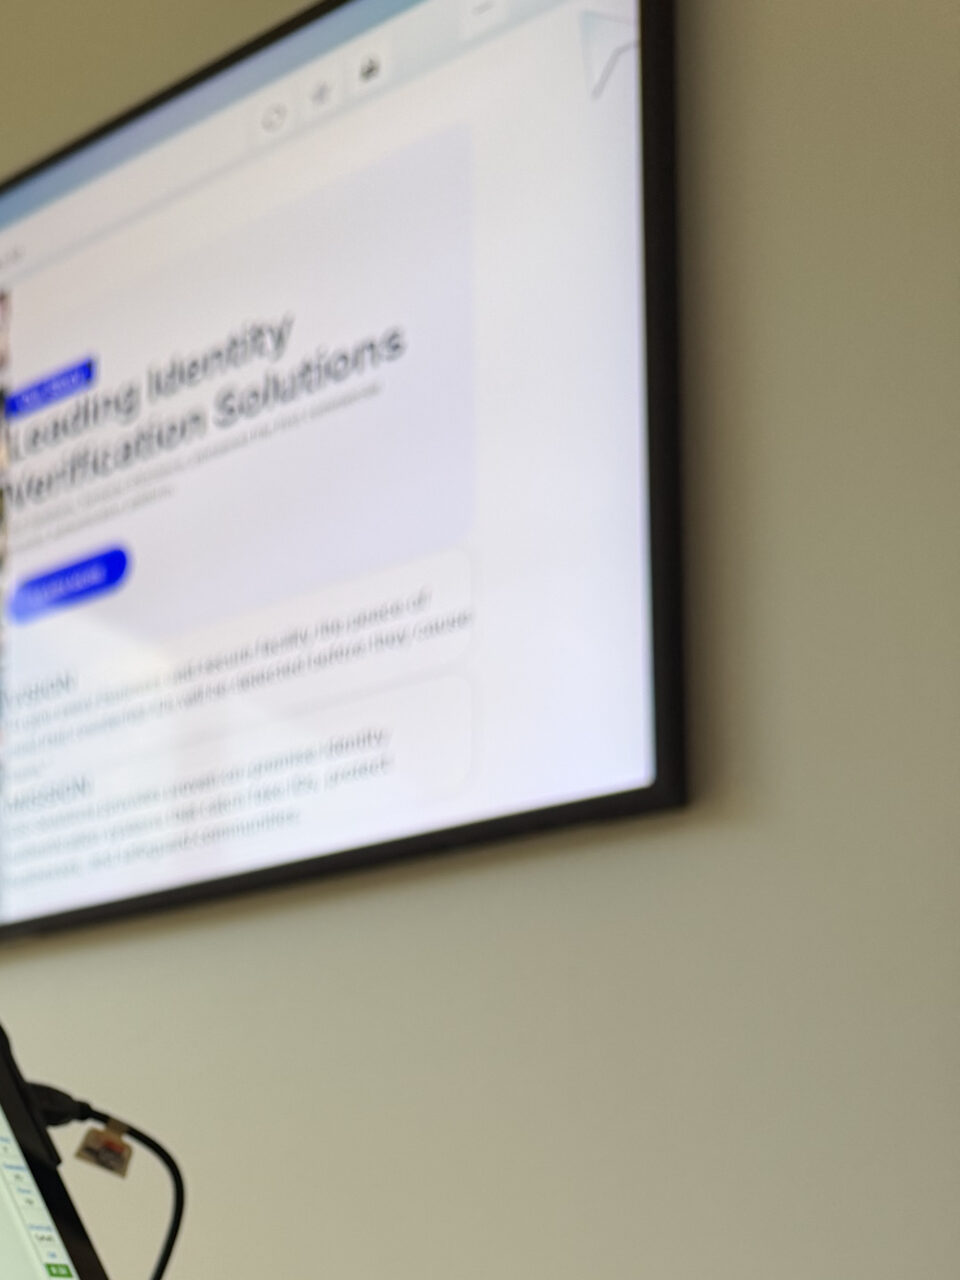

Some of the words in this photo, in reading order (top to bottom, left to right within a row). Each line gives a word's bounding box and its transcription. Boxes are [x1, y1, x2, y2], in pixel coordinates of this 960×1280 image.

[11, 382, 139, 460] Leading
[147, 312, 294, 404] Identity
[213, 326, 406, 427] Solutions
